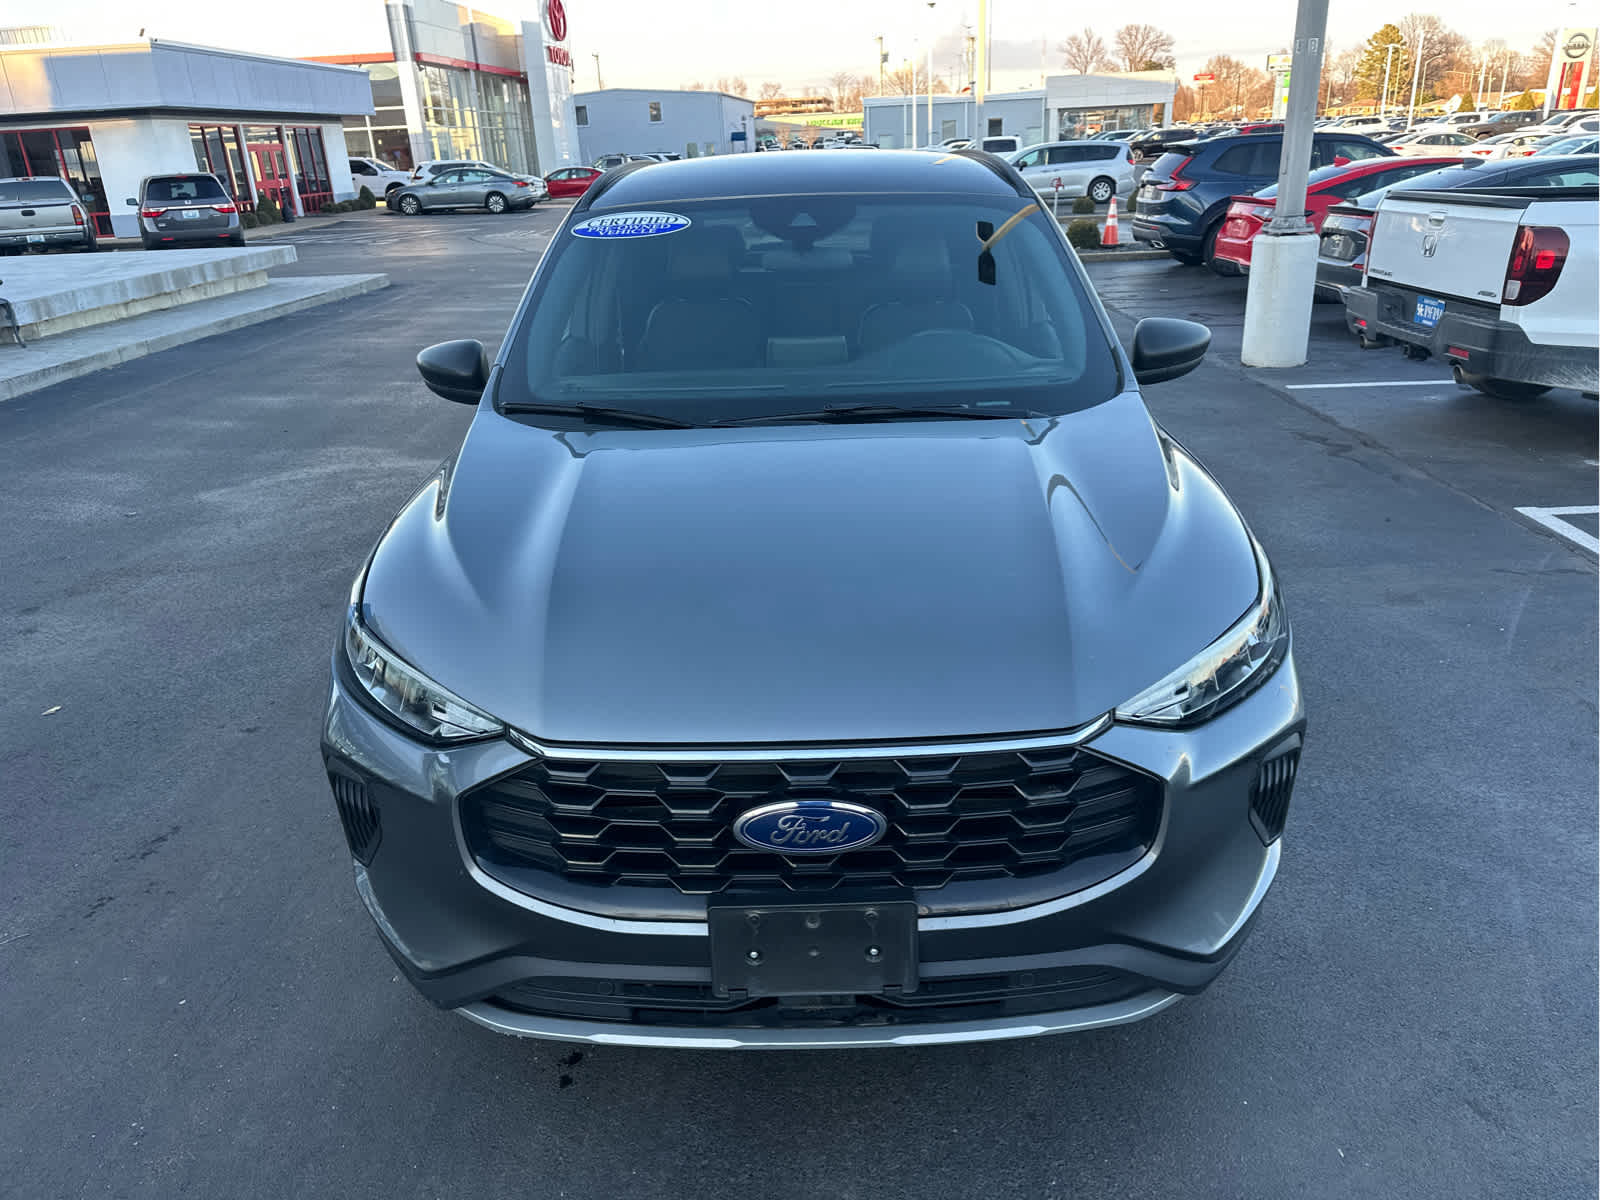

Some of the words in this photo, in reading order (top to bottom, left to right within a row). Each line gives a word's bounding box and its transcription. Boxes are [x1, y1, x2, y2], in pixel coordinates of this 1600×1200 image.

[587, 216, 679, 227] CERTIFIED
[587, 223, 672, 232] PRE-OWNED
[599, 228, 657, 236] VEHICLE
[770, 814, 850, 844] Ford
